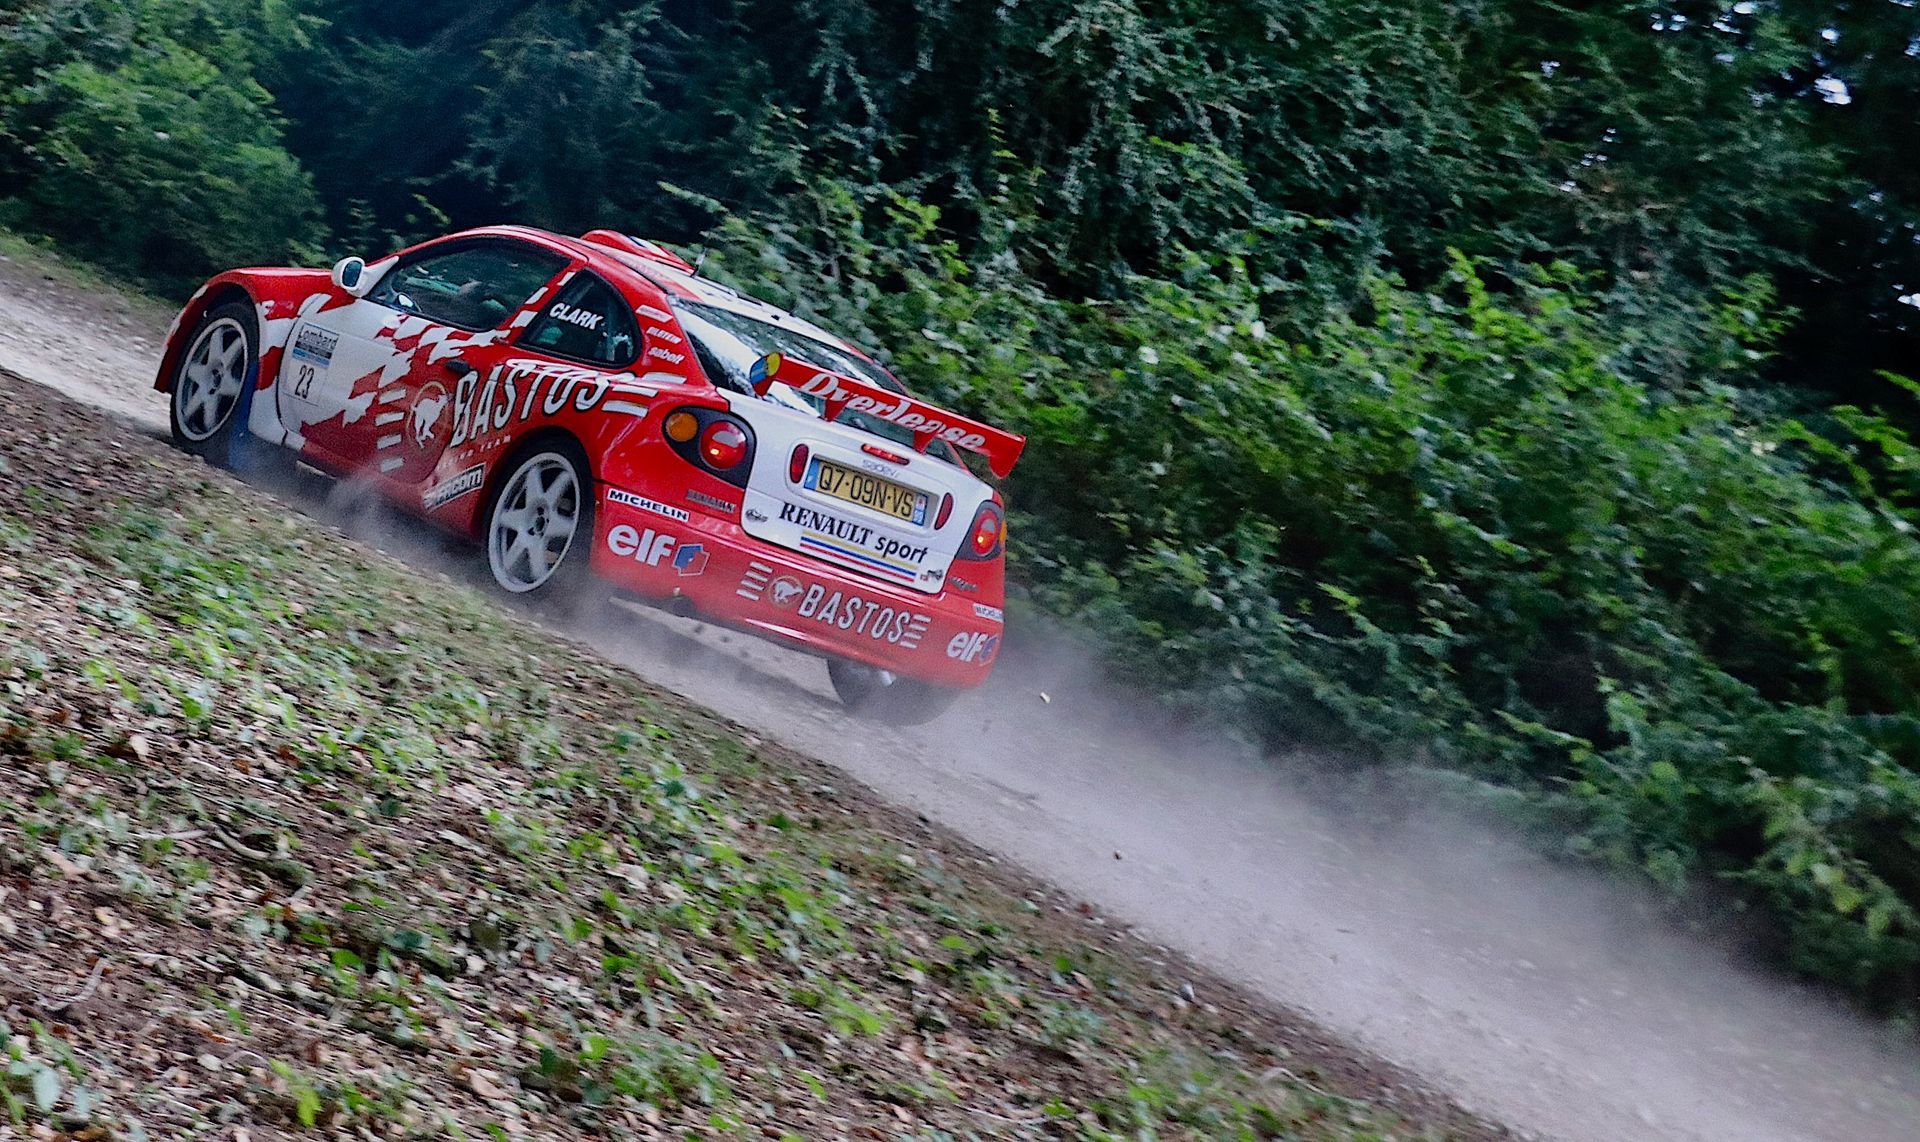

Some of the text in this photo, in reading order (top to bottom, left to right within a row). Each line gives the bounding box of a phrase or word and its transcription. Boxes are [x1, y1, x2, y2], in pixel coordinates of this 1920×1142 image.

[549, 302, 604, 330] CLARK
[294, 364, 315, 399] 23
[450, 358, 635, 449] BASTOS
[609, 489, 688, 521] MICHELIN
[607, 524, 677, 567] elf
[778, 501, 874, 546] RENAULT
[874, 535, 929, 564] sport
[798, 583, 911, 643] BASTOS
[946, 631, 989, 662] elf
